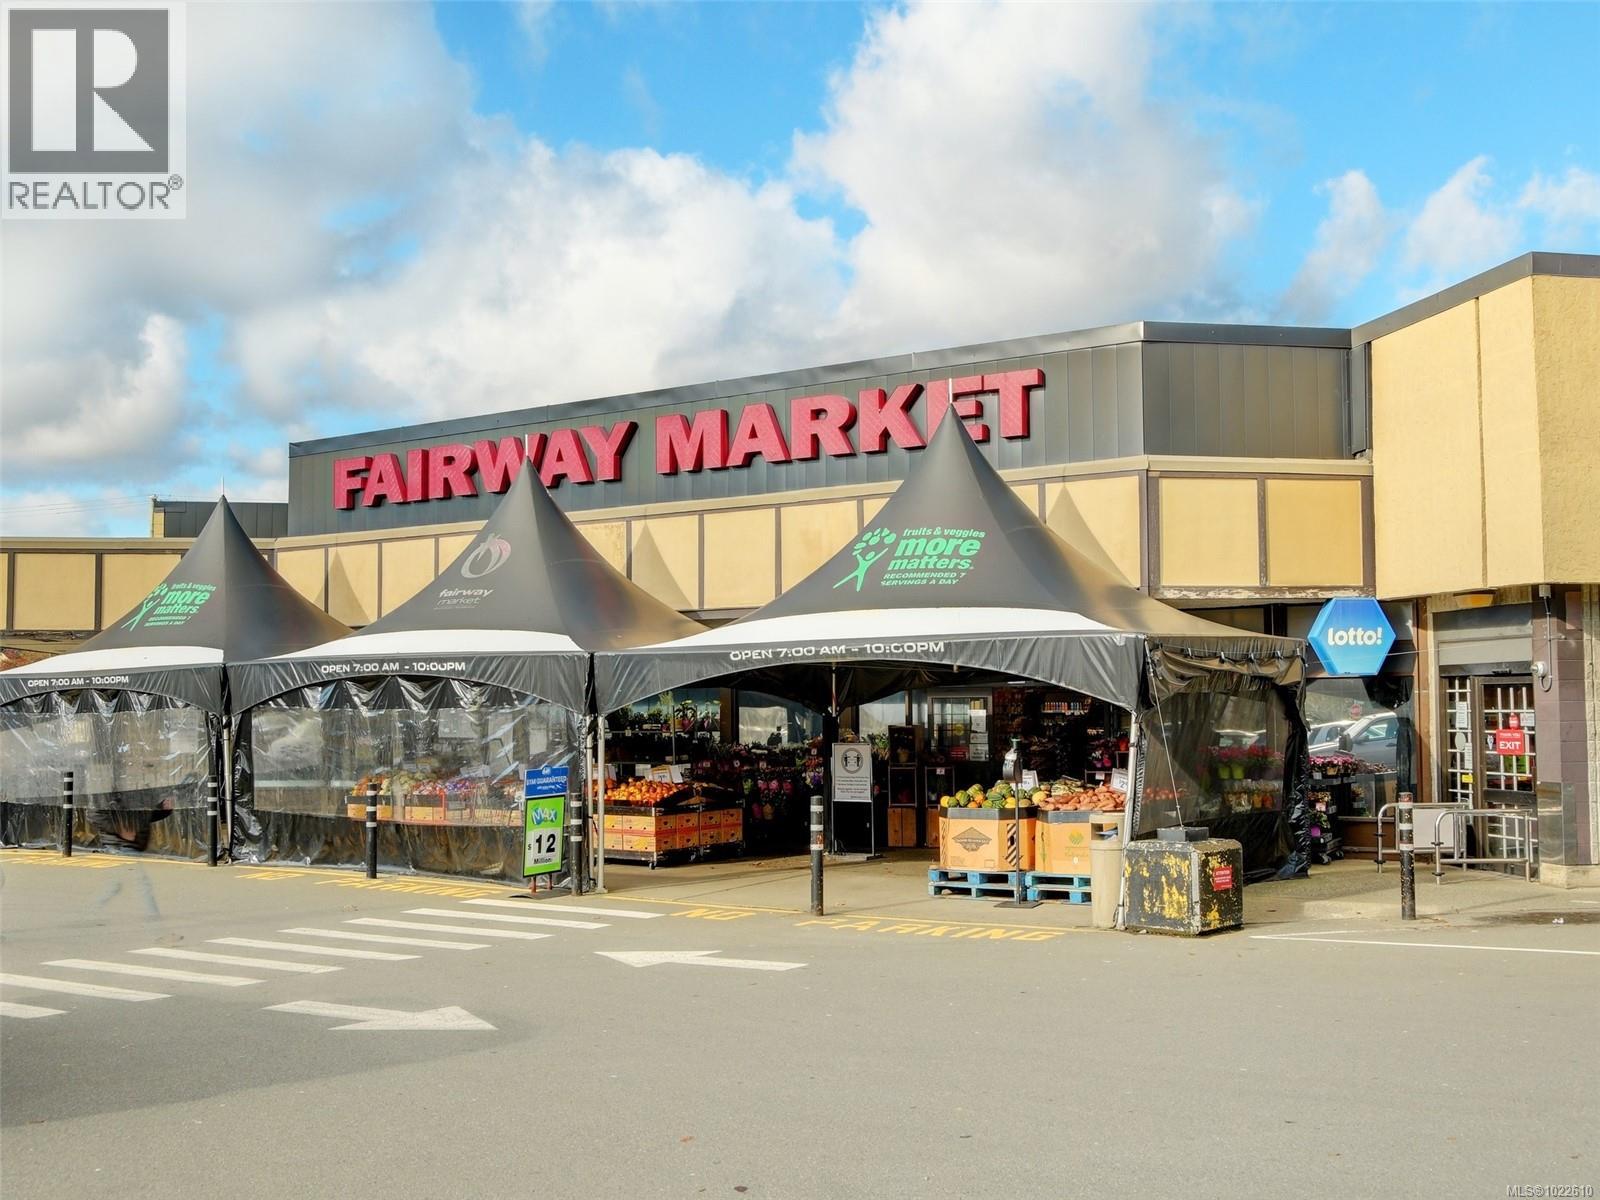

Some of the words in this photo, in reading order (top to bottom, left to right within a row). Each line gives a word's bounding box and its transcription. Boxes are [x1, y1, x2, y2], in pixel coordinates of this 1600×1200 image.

[333, 420, 638, 511] FAIRWAY
[655, 368, 1046, 476] MARKET
[903, 528, 932, 537] fruits
[933, 526, 942, 536] &
[943, 528, 986, 538] veggies
[894, 537, 981, 557] more
[883, 572, 957, 580] RECOMMENDED
[161, 591, 210, 605] more
[440, 588, 494, 598] fairway
[1328, 627, 1383, 646] lotto!
[730, 650, 773, 661] OPEN
[779, 646, 815, 657] 7:00
[819, 645, 846, 656] AM
[321, 664, 350, 674] OPEN
[353, 662, 379, 672] 7:00
[382, 661, 400, 671] AM
[71, 677, 84, 685] AM
[92, 676, 129, 684] 10:00PM
[1499, 741, 1521, 750] EXIT
[536, 834, 556, 853] 12
[670, 908, 756, 920] NO
[794, 918, 1064, 941] PARKING
